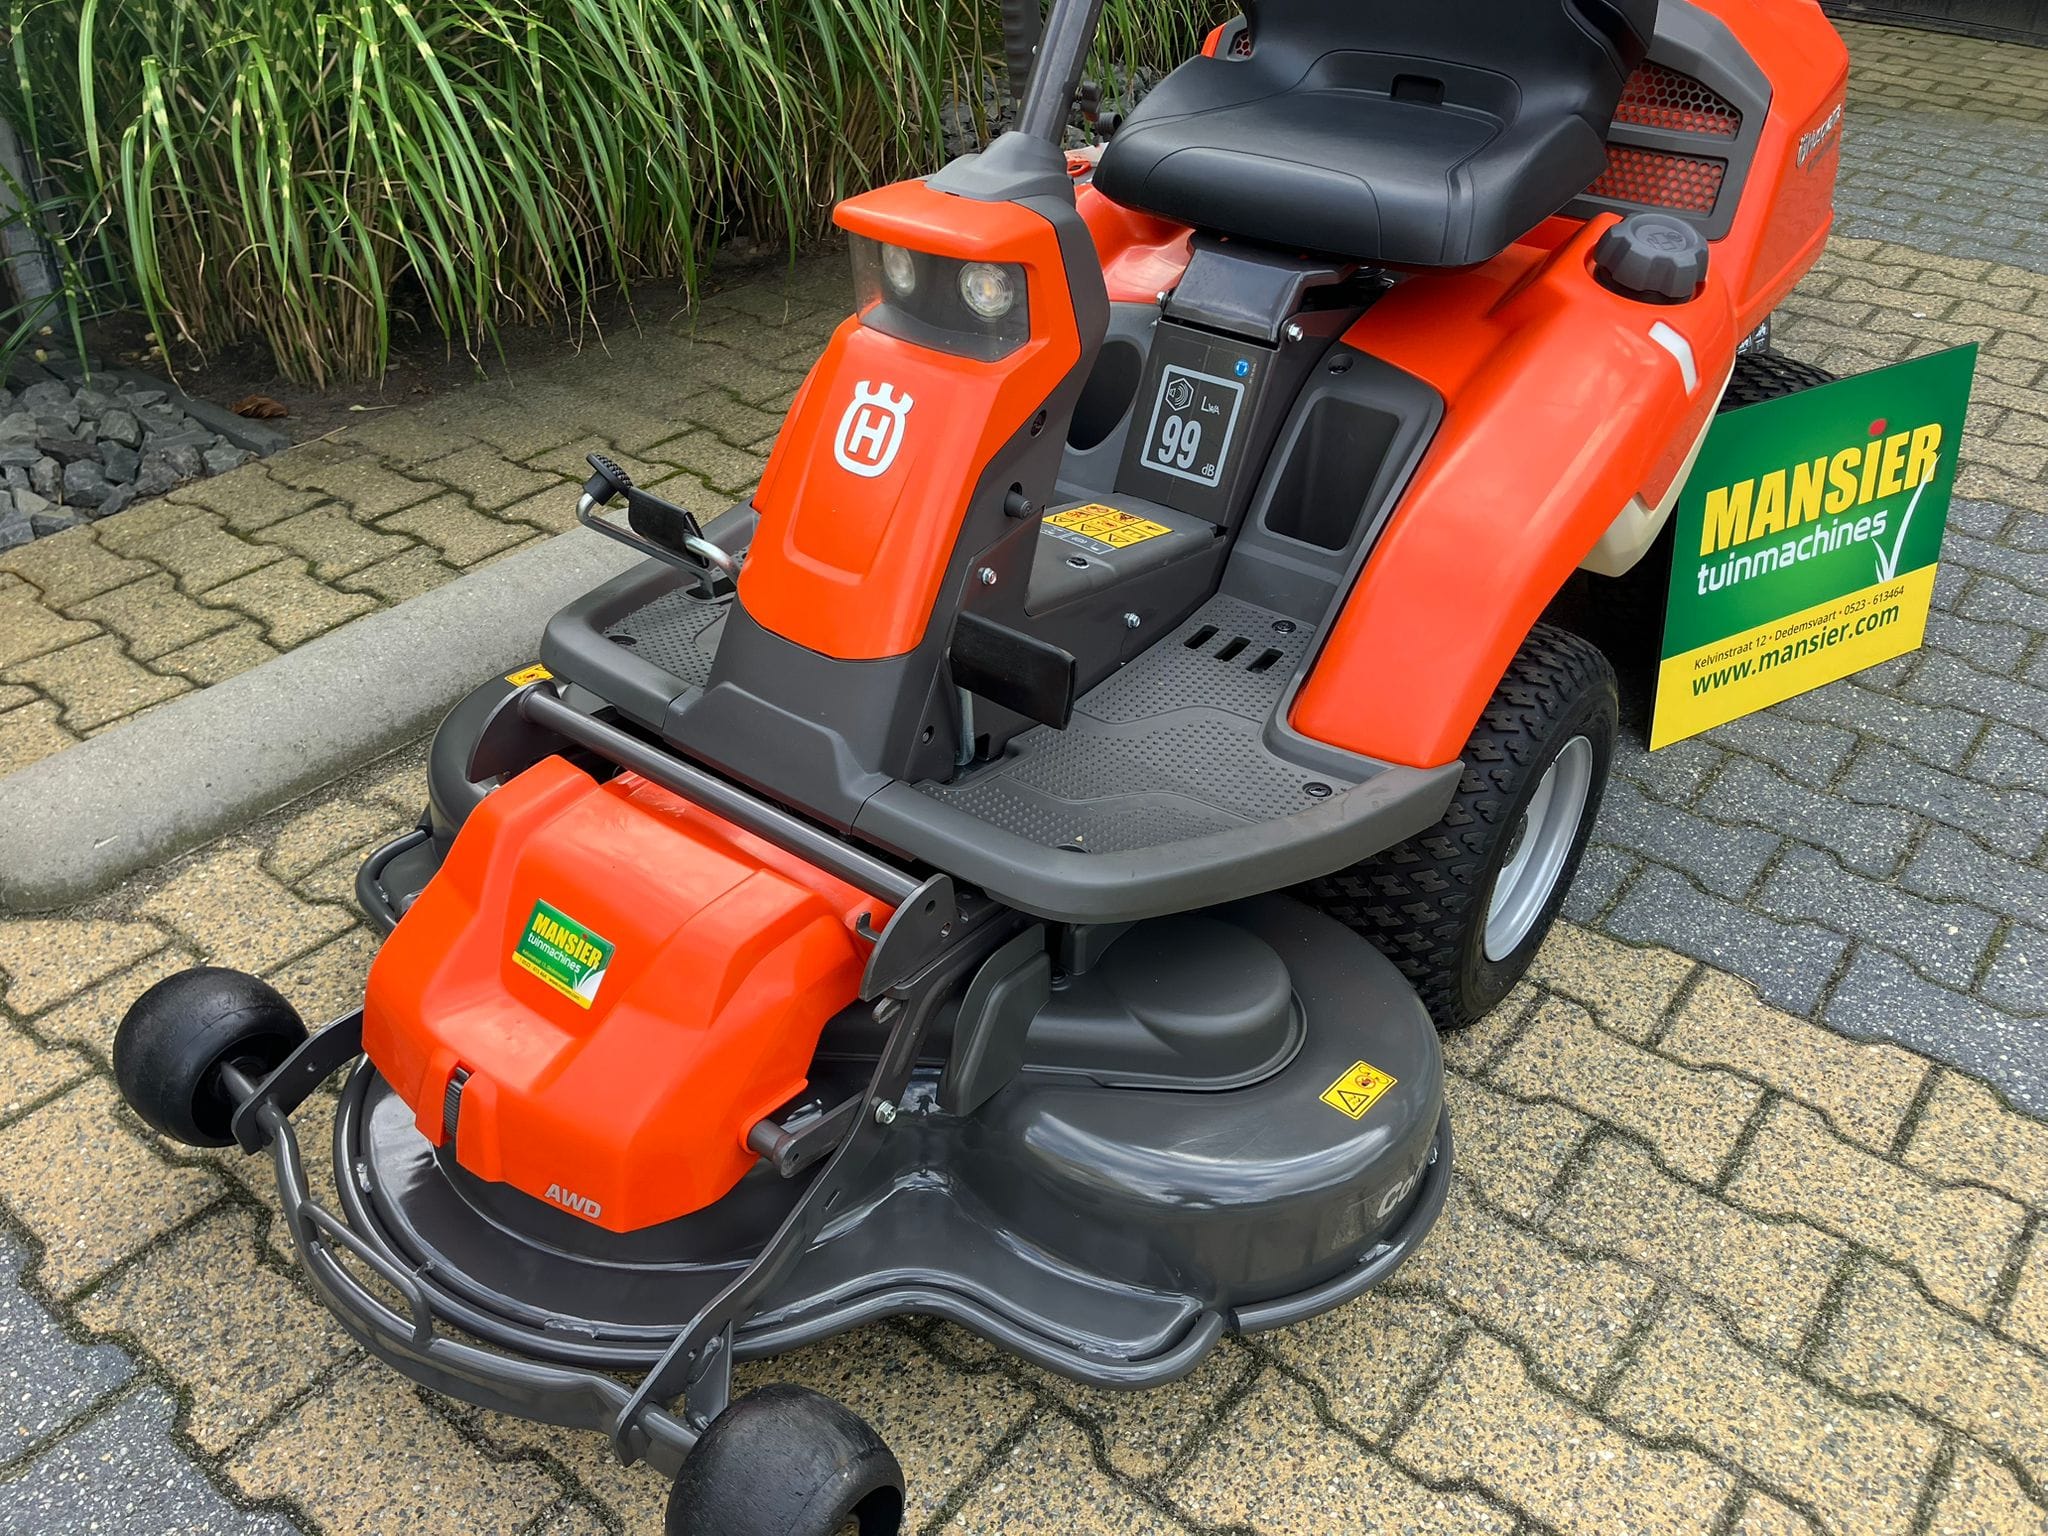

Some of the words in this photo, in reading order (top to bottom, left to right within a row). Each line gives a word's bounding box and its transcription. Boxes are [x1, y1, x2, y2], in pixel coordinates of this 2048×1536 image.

[1158, 415, 1202, 469] 99
[1201, 463, 1215, 477] dB
[1697, 510, 1888, 595] tuinmachines
[1692, 604, 1900, 697] www.mansier.com
[1694, 640, 1753, 670] Kelvinstraat
[1755, 635, 1767, 649] 12
[1775, 611, 1837, 641] Dedemsvaart
[1844, 601, 1866, 616] 0523
[1873, 585, 1905, 605] 613464
[527, 932, 582, 974] tuinmachines
[544, 1183, 602, 1219] AWD
